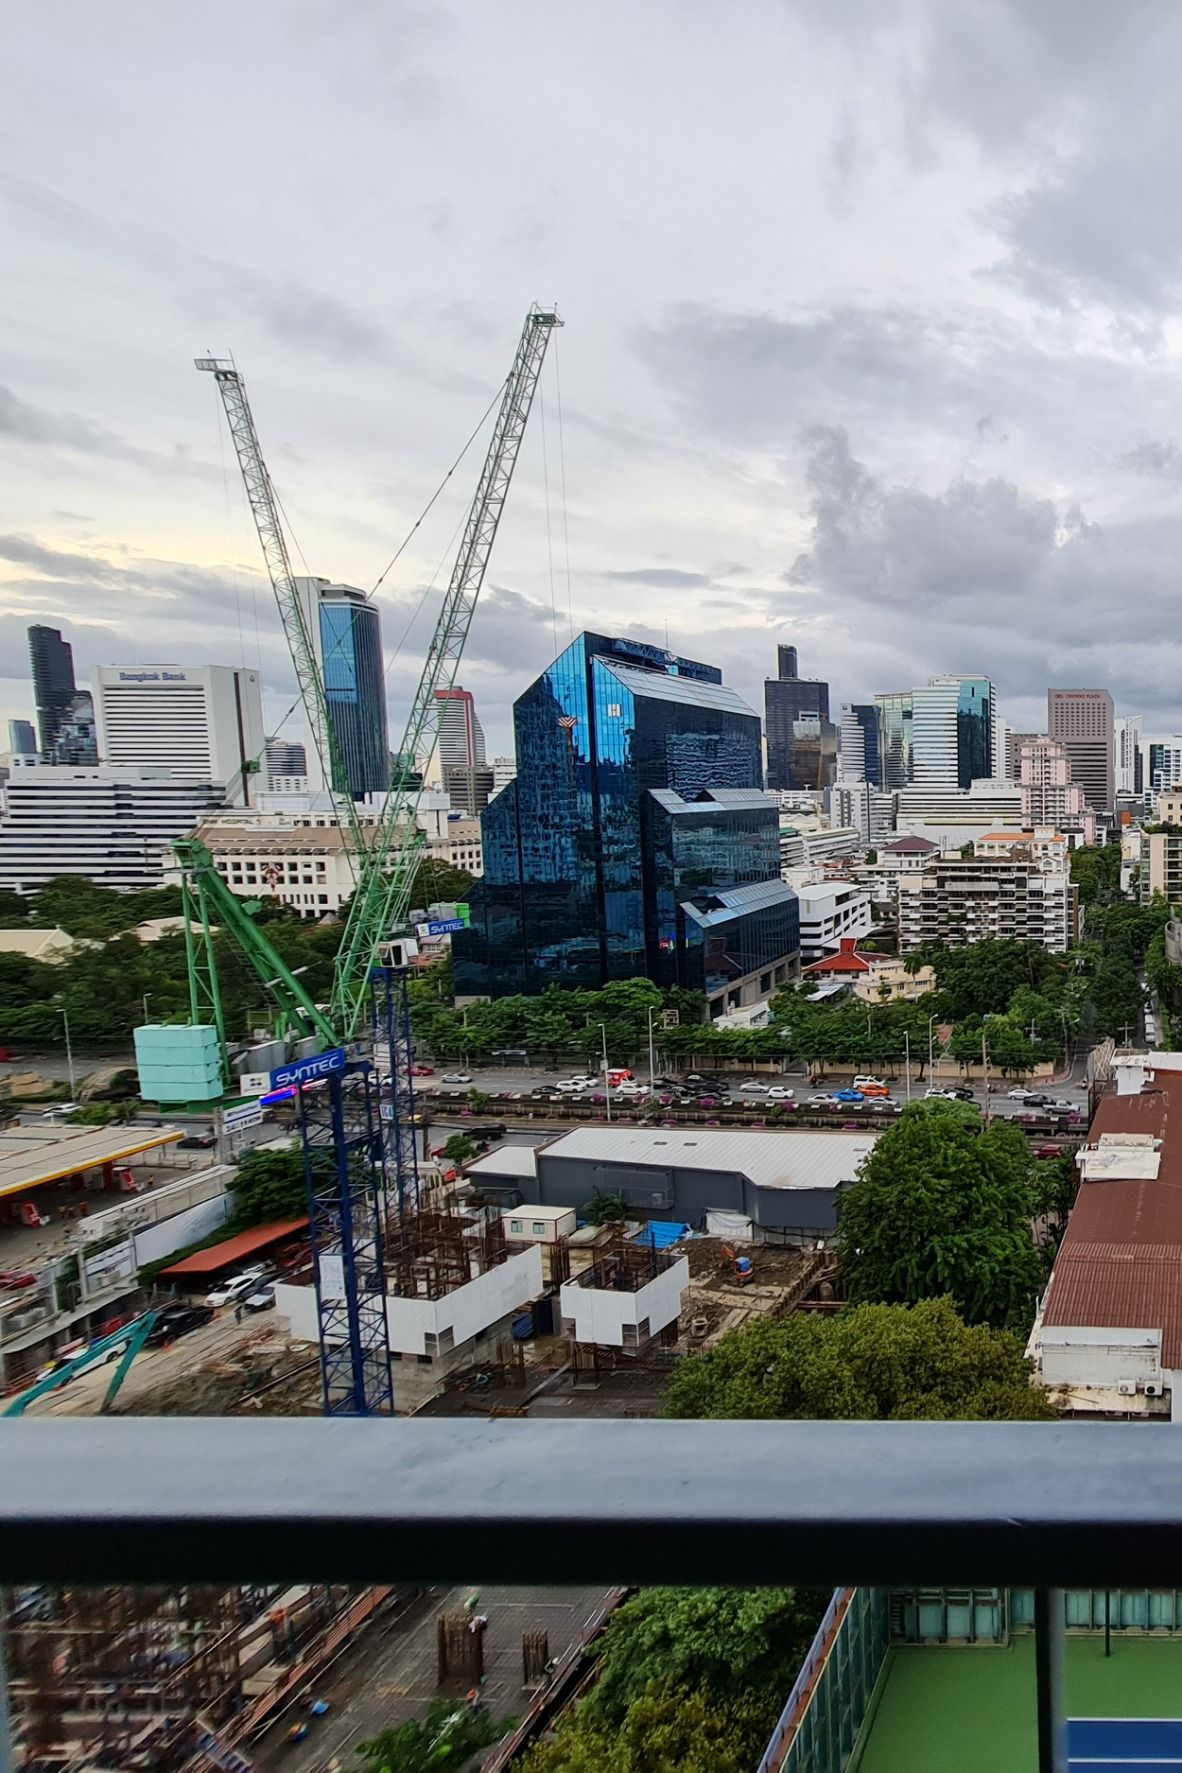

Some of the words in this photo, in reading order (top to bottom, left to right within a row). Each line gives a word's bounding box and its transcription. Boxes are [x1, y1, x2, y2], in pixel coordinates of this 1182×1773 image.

[119, 672, 160, 682] Bangkok
[162, 672, 186, 681] Bank
[276, 1056, 340, 1088] SYNTEC
